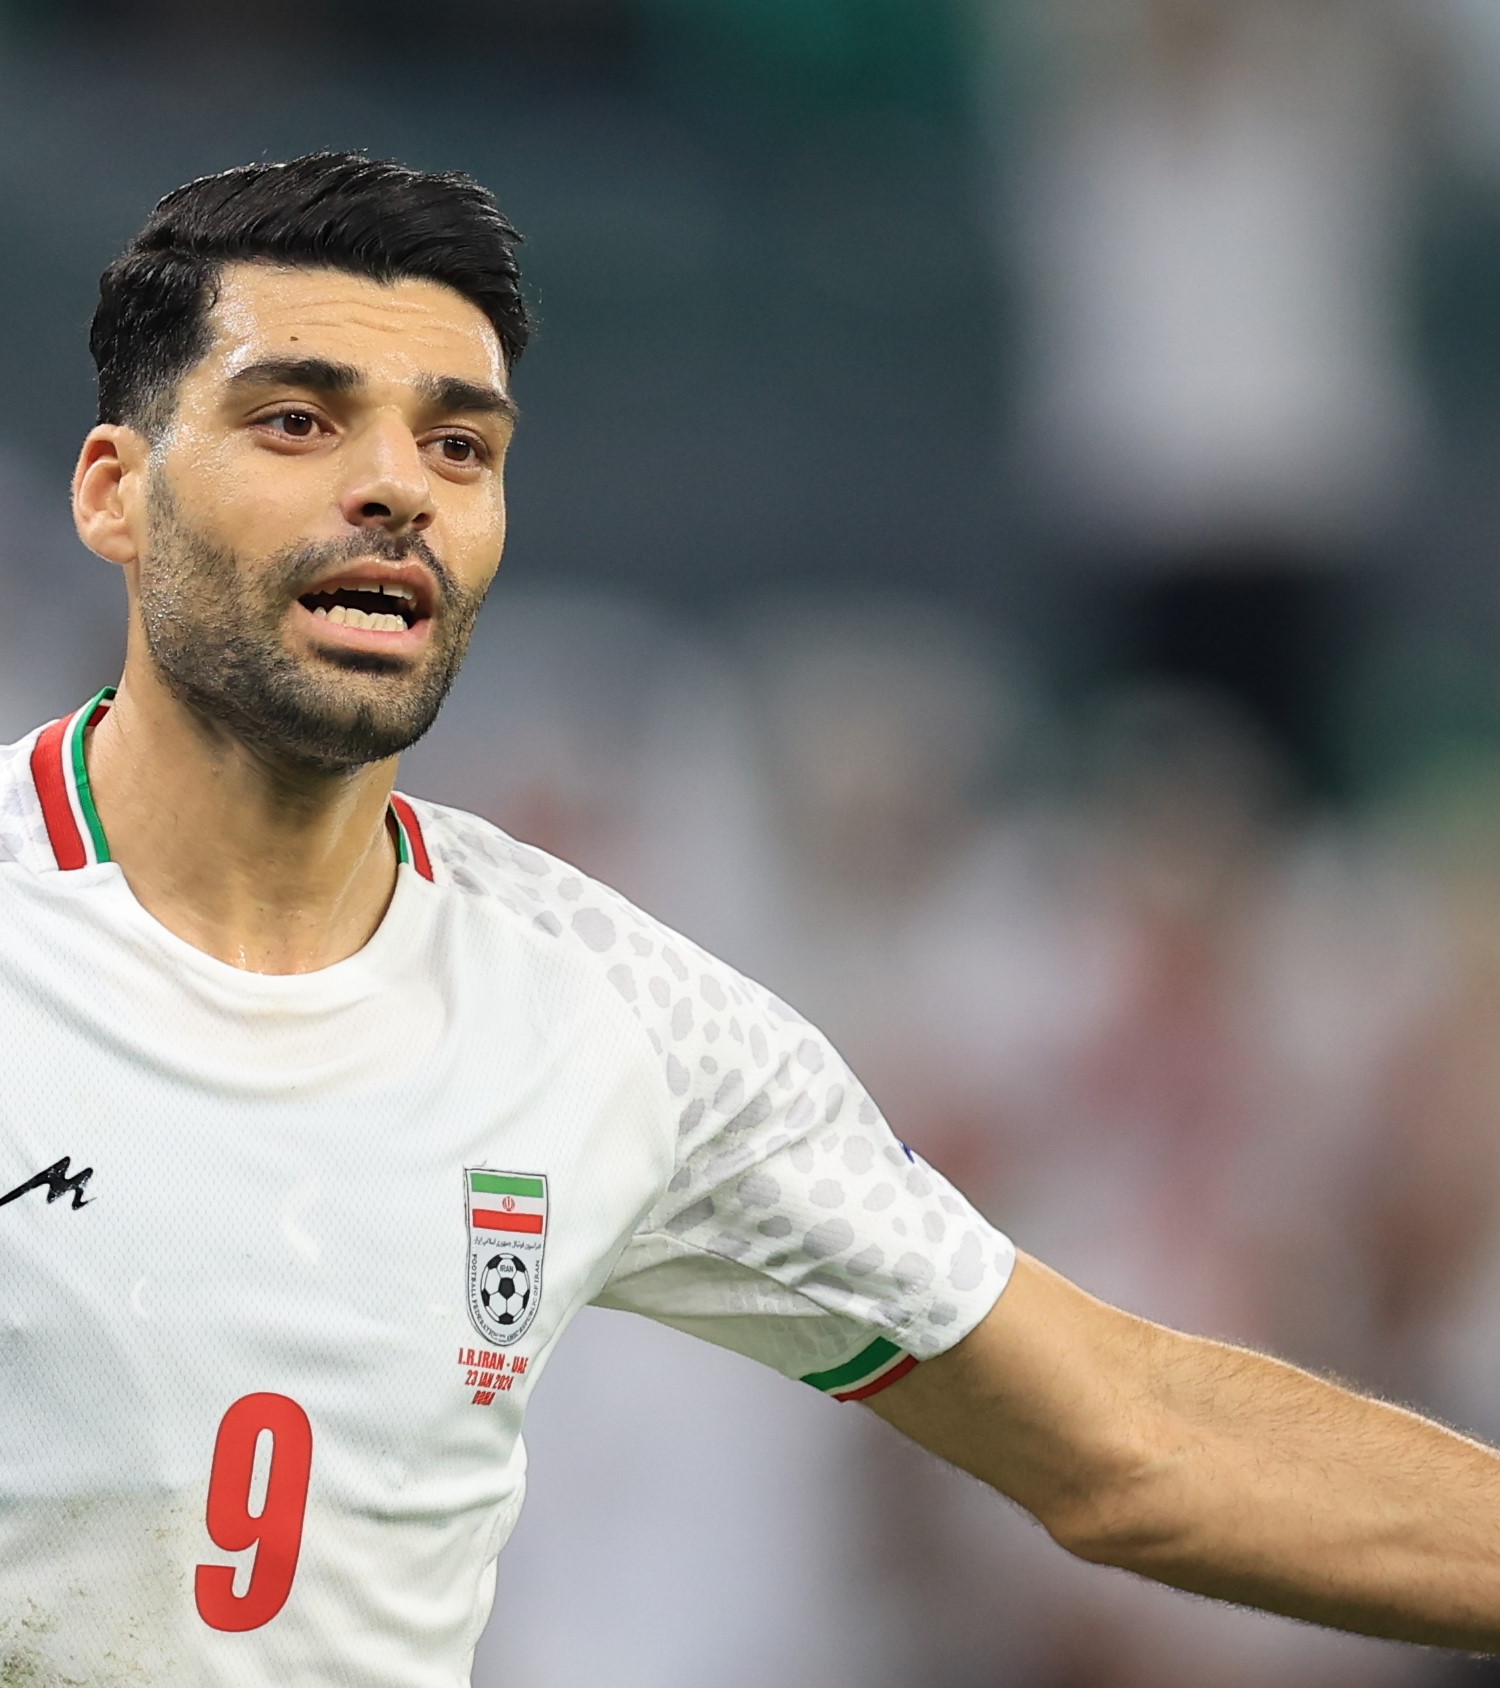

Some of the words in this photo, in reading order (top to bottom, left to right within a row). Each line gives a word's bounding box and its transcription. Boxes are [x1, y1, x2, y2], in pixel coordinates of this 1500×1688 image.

[500, 1264, 514, 1273] IRAN
[458, 1347, 505, 1371] I.R.IRAN
[465, 1369, 478, 1386] 23
[477, 1371, 495, 1388] JAN
[492, 1374, 514, 1391] 2024
[194, 1391, 313, 1632] 9
